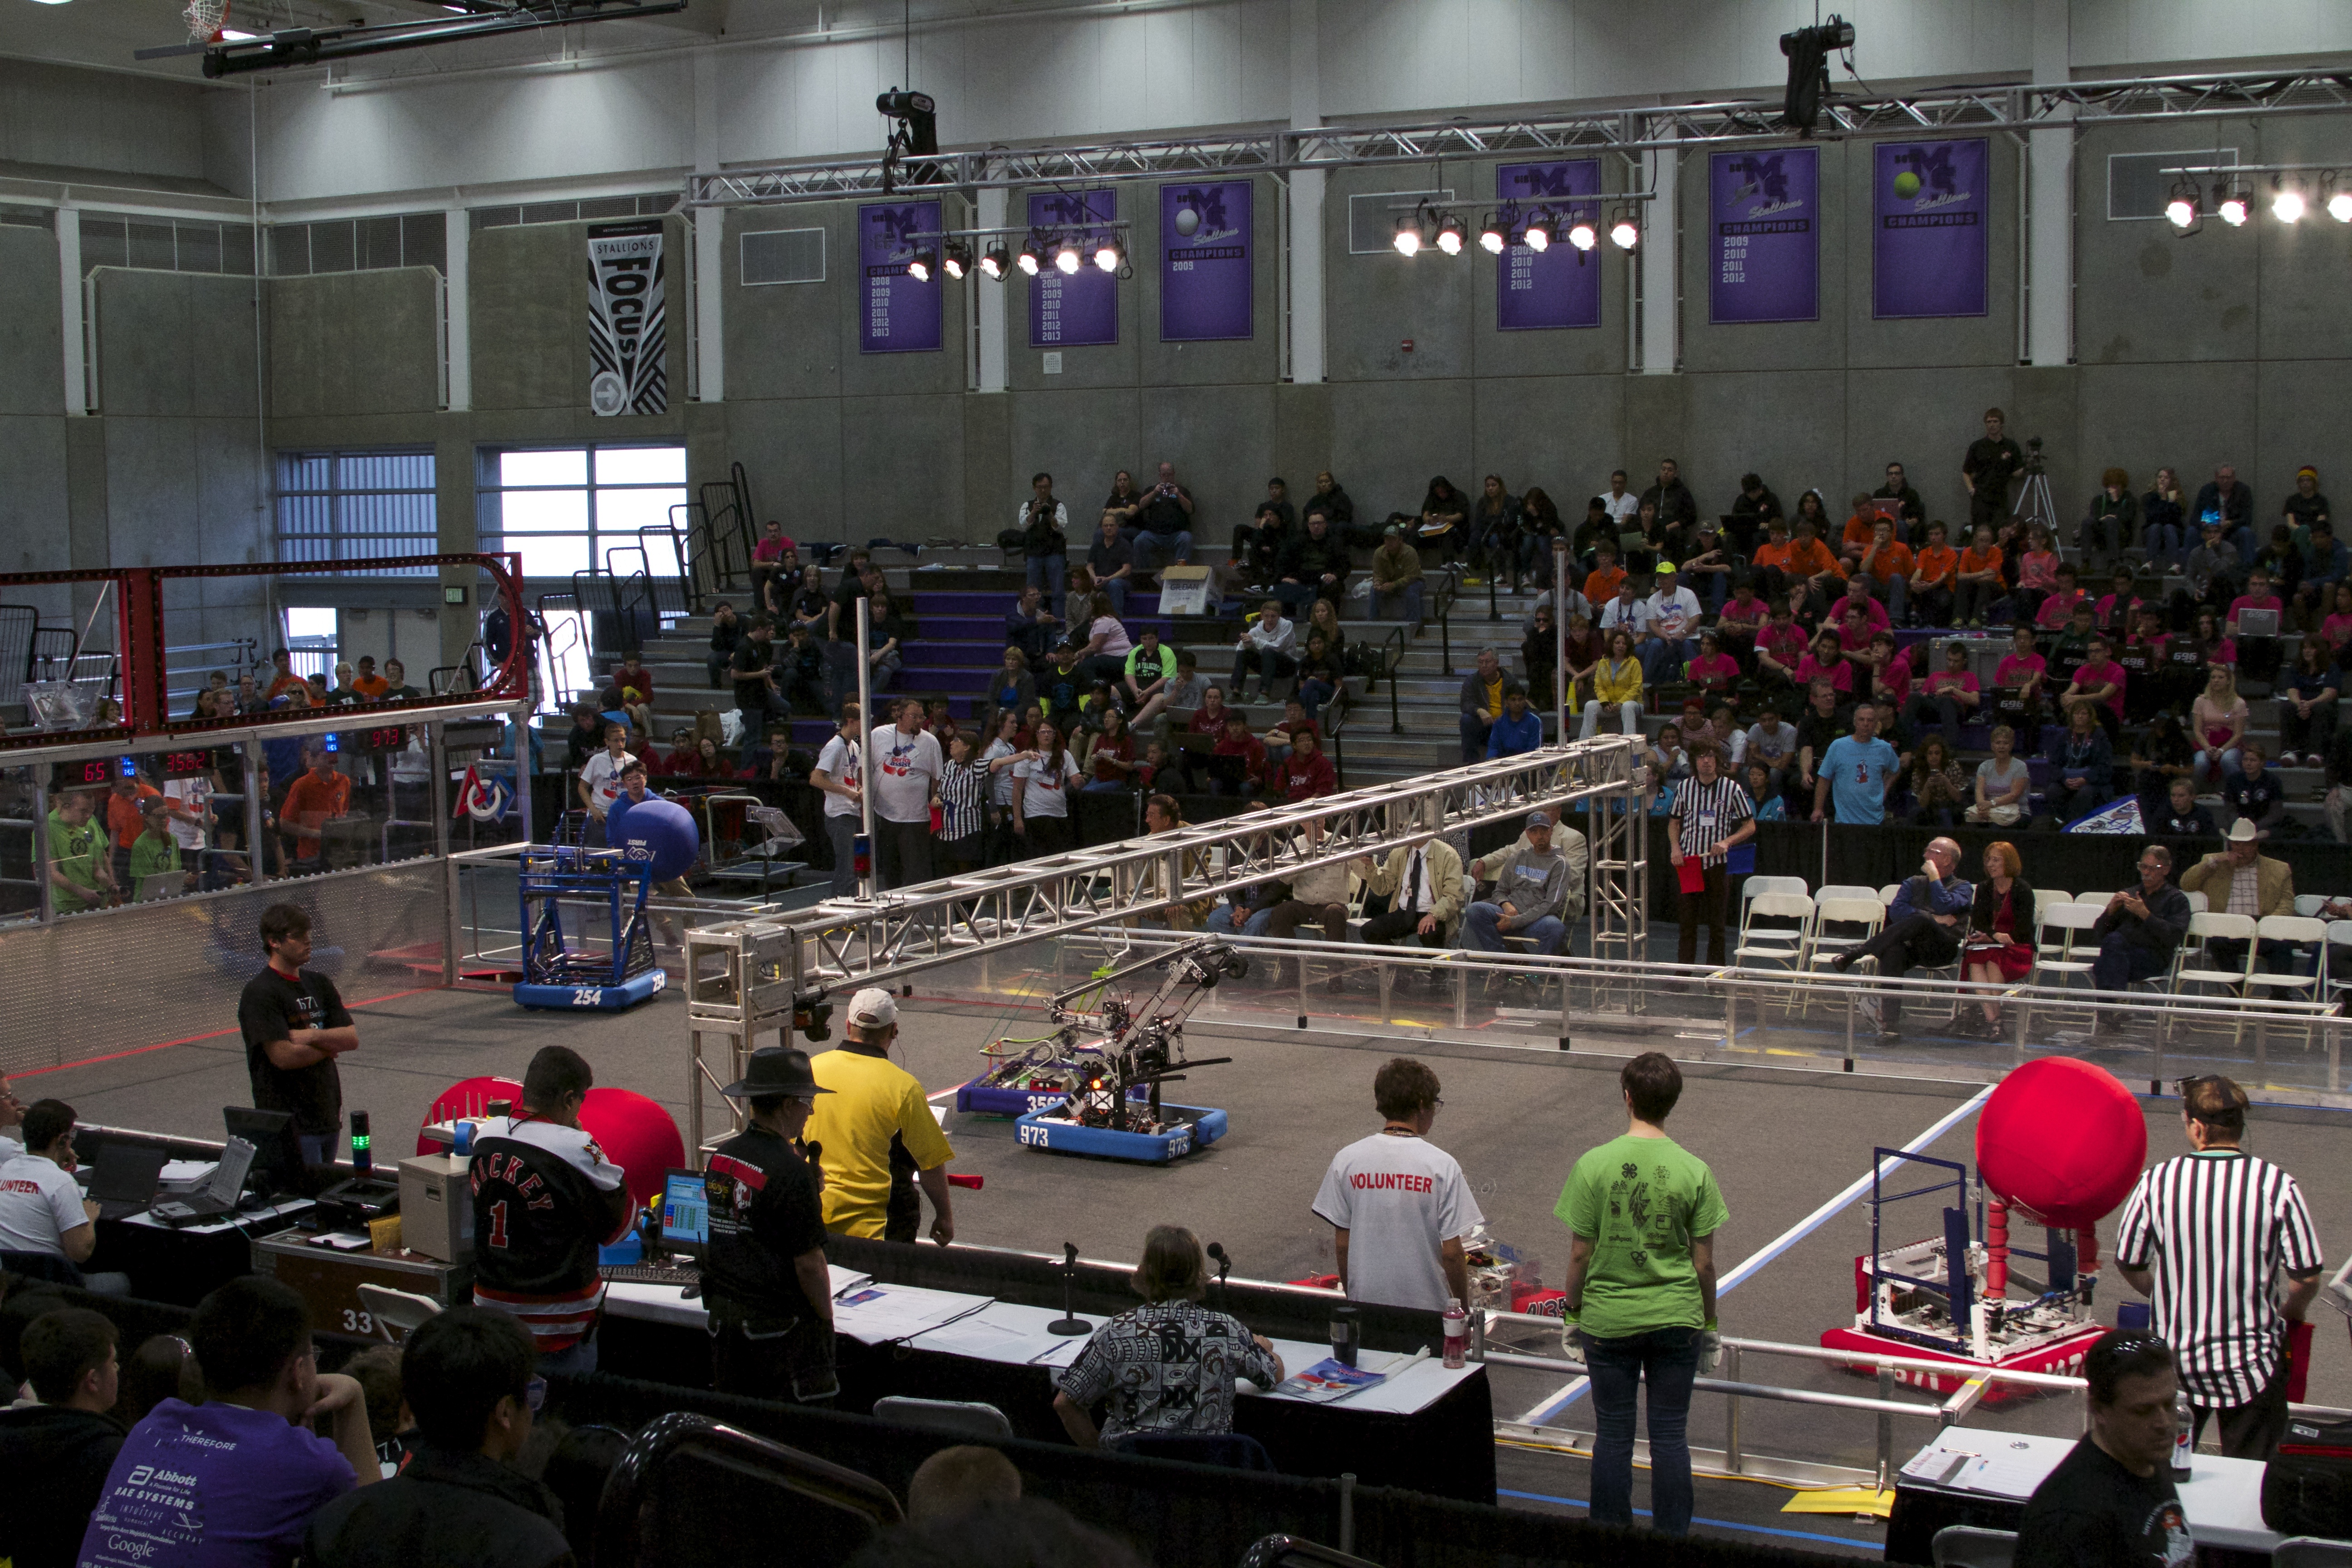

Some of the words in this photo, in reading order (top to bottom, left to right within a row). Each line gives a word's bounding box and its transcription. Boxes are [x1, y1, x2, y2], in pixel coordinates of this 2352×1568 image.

[1887, 214, 1974, 226] CHAMPIONS
[1724, 221, 1806, 233] CHAMPIONS
[1725, 236, 1748, 247] 2009
[598, 241, 654, 254] STALLIONS
[1171, 249, 1242, 259] CHAMPIONS
[1724, 249, 1746, 259] 2010
[1173, 261, 1194, 271] 2009
[1511, 257, 1532, 267] 2010
[1723, 261, 1743, 271] 2011
[870, 266, 909, 275] CHAMP
[1511, 269, 1530, 278] 2011
[872, 277, 890, 286] 2008
[1723, 272, 1745, 283] 2012
[1042, 279, 1061, 288] 2008
[1511, 280, 1532, 290] 2012
[872, 288, 890, 297] 2009
[1042, 289, 1062, 299] 2009
[601, 256, 651, 353] FOCUS
[872, 298, 889, 307] 2010
[1042, 300, 1060, 309] 2010
[872, 308, 887, 317] 2011
[1042, 311, 1058, 320] 2011
[872, 318, 889, 327] 2012
[1042, 321, 1060, 330] 2012
[872, 328, 889, 337] 2013
[1043, 331, 1060, 340] 2013
[2121, 657, 2145, 667] 696
[2173, 652, 2197, 661] 696
[2000, 700, 2025, 710] 696
[372, 729, 399, 748] 973
[167, 752, 205, 772] 3562
[85, 762, 104, 781] 65
[652, 972, 666, 993] 254
[573, 989, 603, 1005] 254
[1020, 1125, 1049, 1147] 973
[1168, 1136, 1188, 1160] 973
[0, 1180, 39, 1194] UNTEER
[1349, 1173, 1432, 1194] VOLUNTEER
[489, 1200, 509, 1248] 1
[343, 1309, 372, 1333] 33
[181, 1434, 237, 1451] THEREFORE
[376, 1437, 402, 1462] 71
[153, 1470, 197, 1487] Abbott
[114, 1487, 134, 1498] BAE
[136, 1490, 195, 1510] SYSTEMS
[120, 1504, 164, 1520] INTUITIVE
[124, 1517, 149, 1526] SURGICAL
[147, 1533, 176, 1545] Foundation
[162, 1529, 204, 1545] ACCURAY
[108, 1534, 155, 1560] Google
